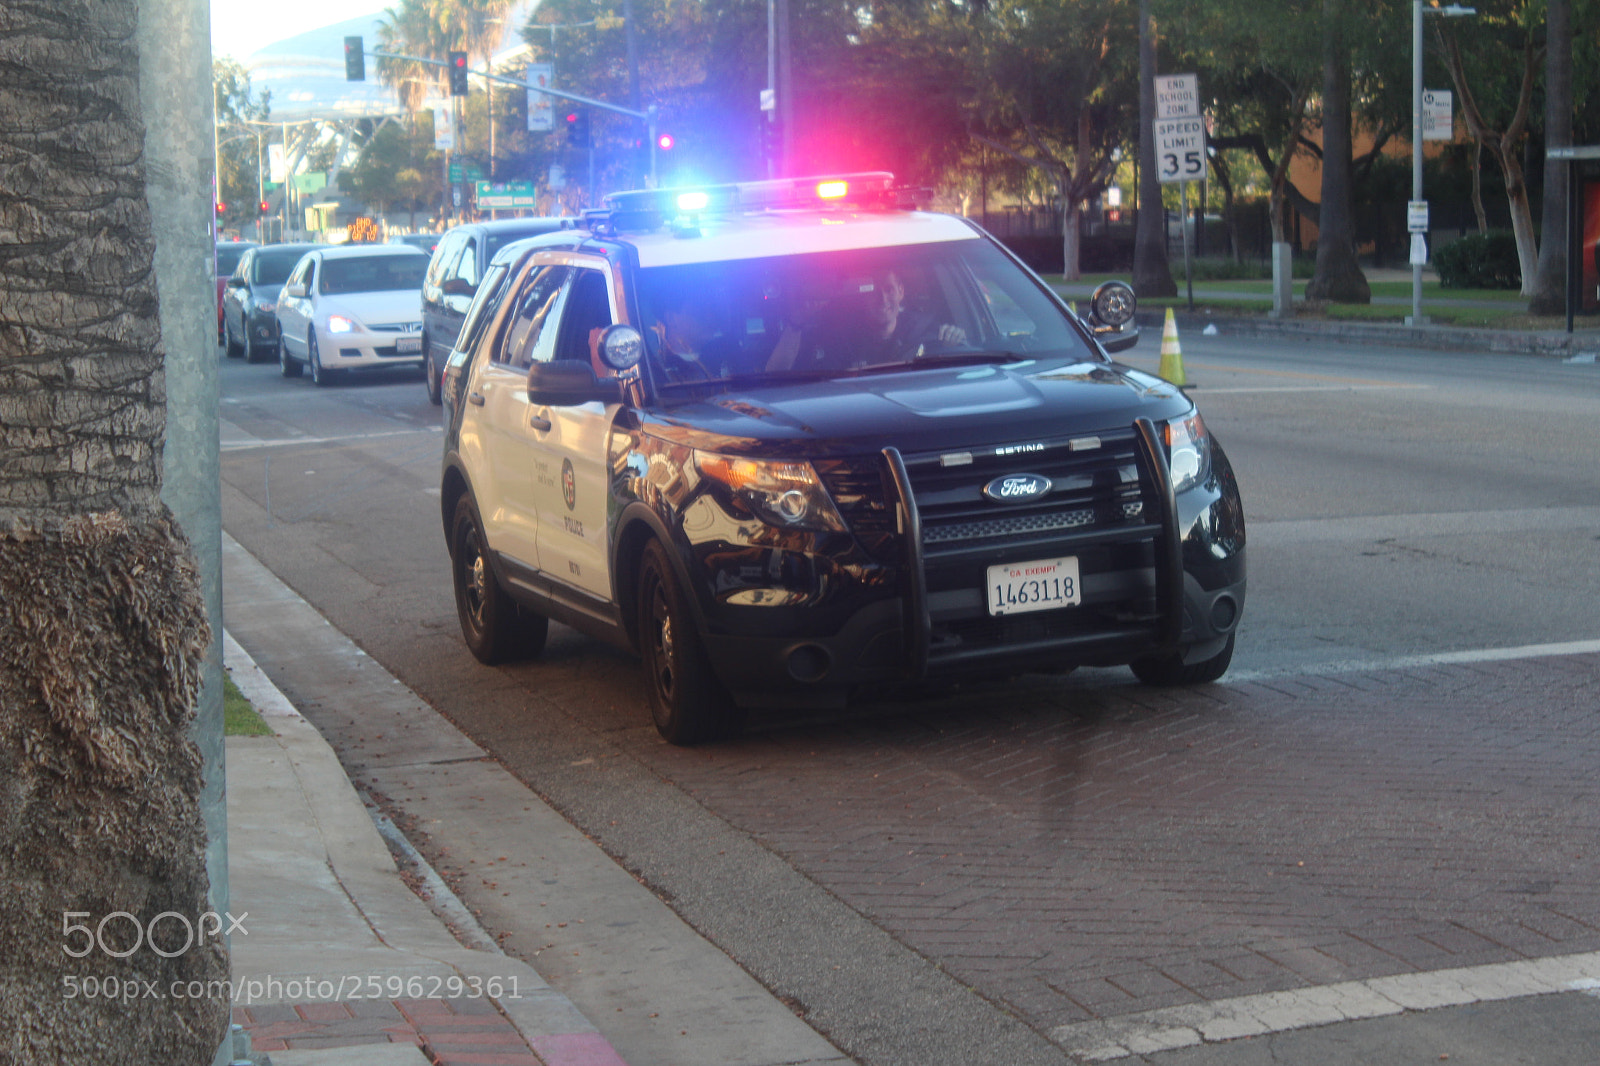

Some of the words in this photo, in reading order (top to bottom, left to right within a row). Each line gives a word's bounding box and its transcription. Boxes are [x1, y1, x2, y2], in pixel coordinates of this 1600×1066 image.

[1167, 80, 1184, 89] END
[1160, 92, 1193, 102] SCHOOL
[1167, 104, 1188, 114] ZONE
[1160, 122, 1199, 134] SPEED
[1163, 137, 1196, 149] LIMIT
[1163, 152, 1202, 177] 35
[1001, 477, 1037, 496] Ford
[564, 516, 584, 537] POLICE
[1009, 569, 1021, 578] CA
[1025, 565, 1057, 576] EXEMPT
[995, 576, 1074, 607] 1463118
